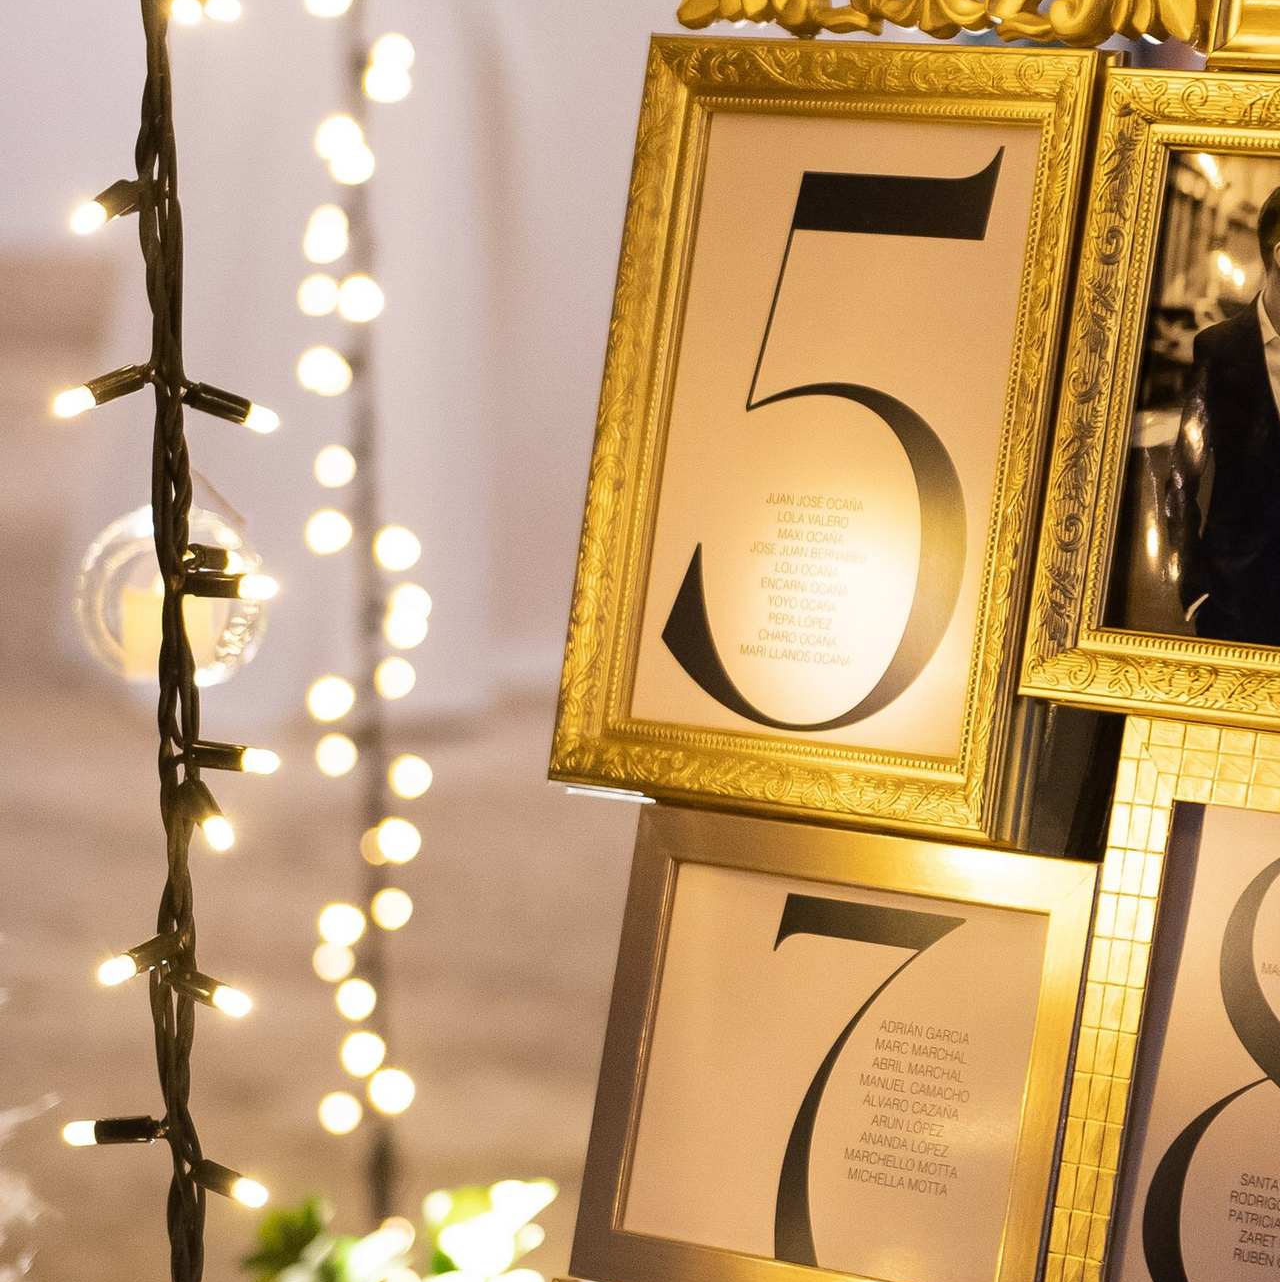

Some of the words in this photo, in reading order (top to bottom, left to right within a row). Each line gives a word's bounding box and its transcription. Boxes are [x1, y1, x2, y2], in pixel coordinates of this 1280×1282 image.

[662, 146, 1005, 732] 5
[766, 493, 794, 506] JUAN
[777, 511, 804, 525] LOLA
[808, 514, 848, 528] VALERO
[778, 528, 803, 542] MAXI
[780, 545, 808, 559] JUAN
[775, 561, 798, 574] LOLI
[761, 577, 807, 592] ENCARNI
[768, 595, 797, 609] YOYO
[768, 612, 795, 626] PEPA
[758, 628, 796, 643] CHARO
[879, 1020, 923, 1038] ADRIÁN
[875, 1038, 909, 1055] MARC
[911, 1044, 968, 1064] MARCHAL
[872, 1057, 904, 1073] ABRIL
[908, 1063, 963, 1083] MARCHAL
[774, 893, 966, 1267] 7
[860, 1074, 906, 1093] MANUEL
[910, 1081, 970, 1103] CAMACHO
[912, 1101, 959, 1121] CAZAÑA
[860, 1132, 907, 1151] ANANDA
[844, 1148, 915, 1172] MARCHELLO
[918, 1160, 958, 1179] MOTTA
[848, 1168, 905, 1189] MICHELLA
[908, 1178, 948, 1197] MOTTA
[1241, 1173, 1278, 1192] SANTA
[1228, 1209, 1280, 1230] PATRICIA
[1239, 1230, 1277, 1248] ZARET
